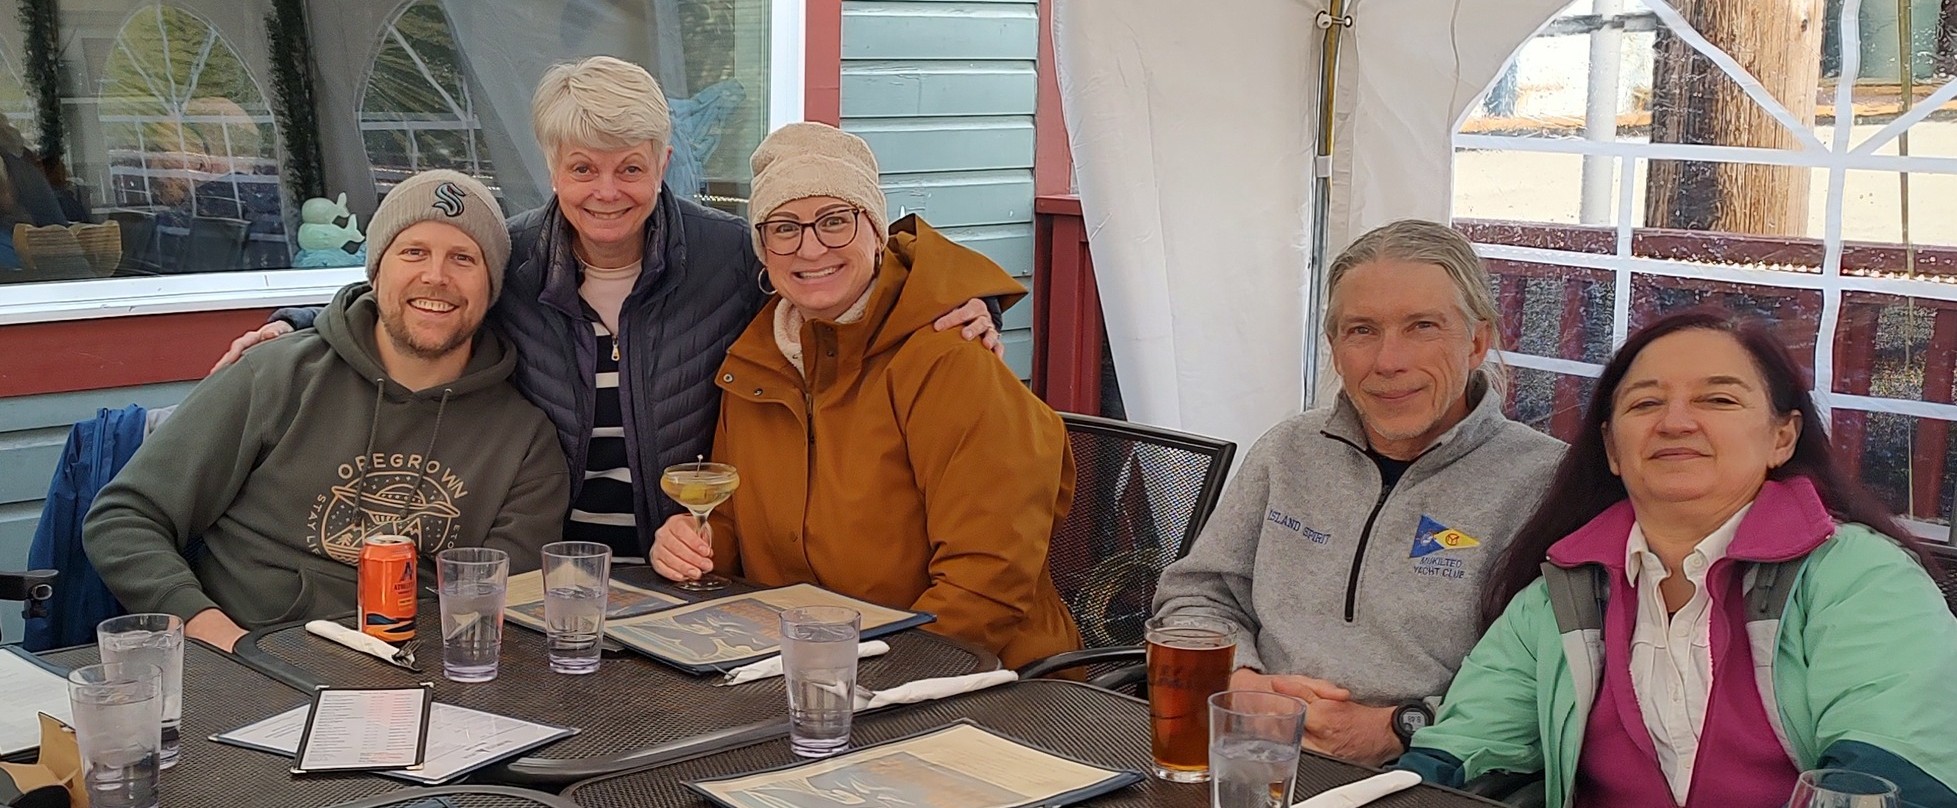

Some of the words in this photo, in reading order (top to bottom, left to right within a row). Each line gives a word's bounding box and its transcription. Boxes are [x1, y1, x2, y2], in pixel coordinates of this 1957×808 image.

[307, 493, 326, 531] STAY
[1267, 509, 1301, 531] ISLAND
[1303, 526, 1331, 545] SPIRIT
[1413, 566, 1440, 575] YACHT
[1442, 568, 1465, 579] CLUB
